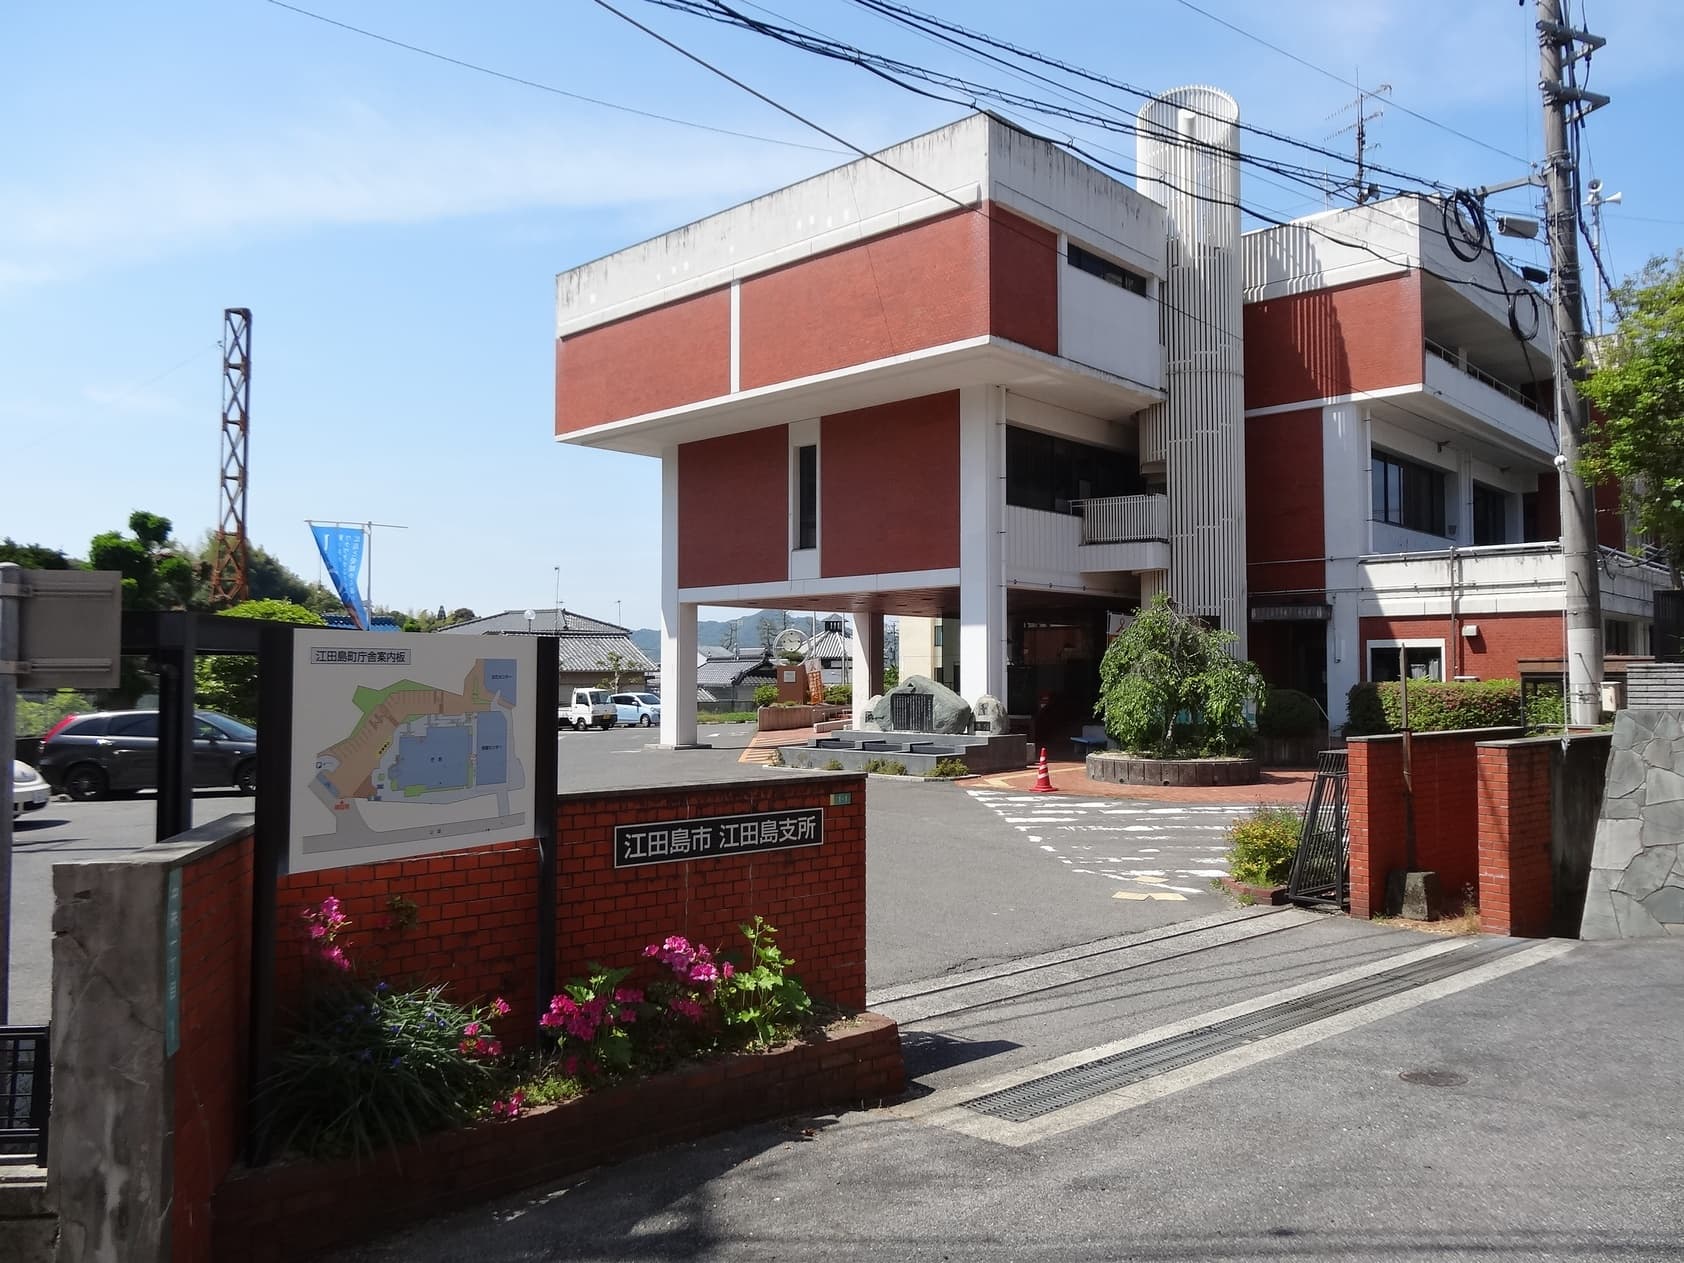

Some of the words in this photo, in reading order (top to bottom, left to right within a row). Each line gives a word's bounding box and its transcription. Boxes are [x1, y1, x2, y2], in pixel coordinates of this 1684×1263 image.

[315, 650, 406, 663] 江田島町庁舎案内板
[624, 826, 713, 860] 江田島市
[719, 815, 817, 849] 江田島支所
